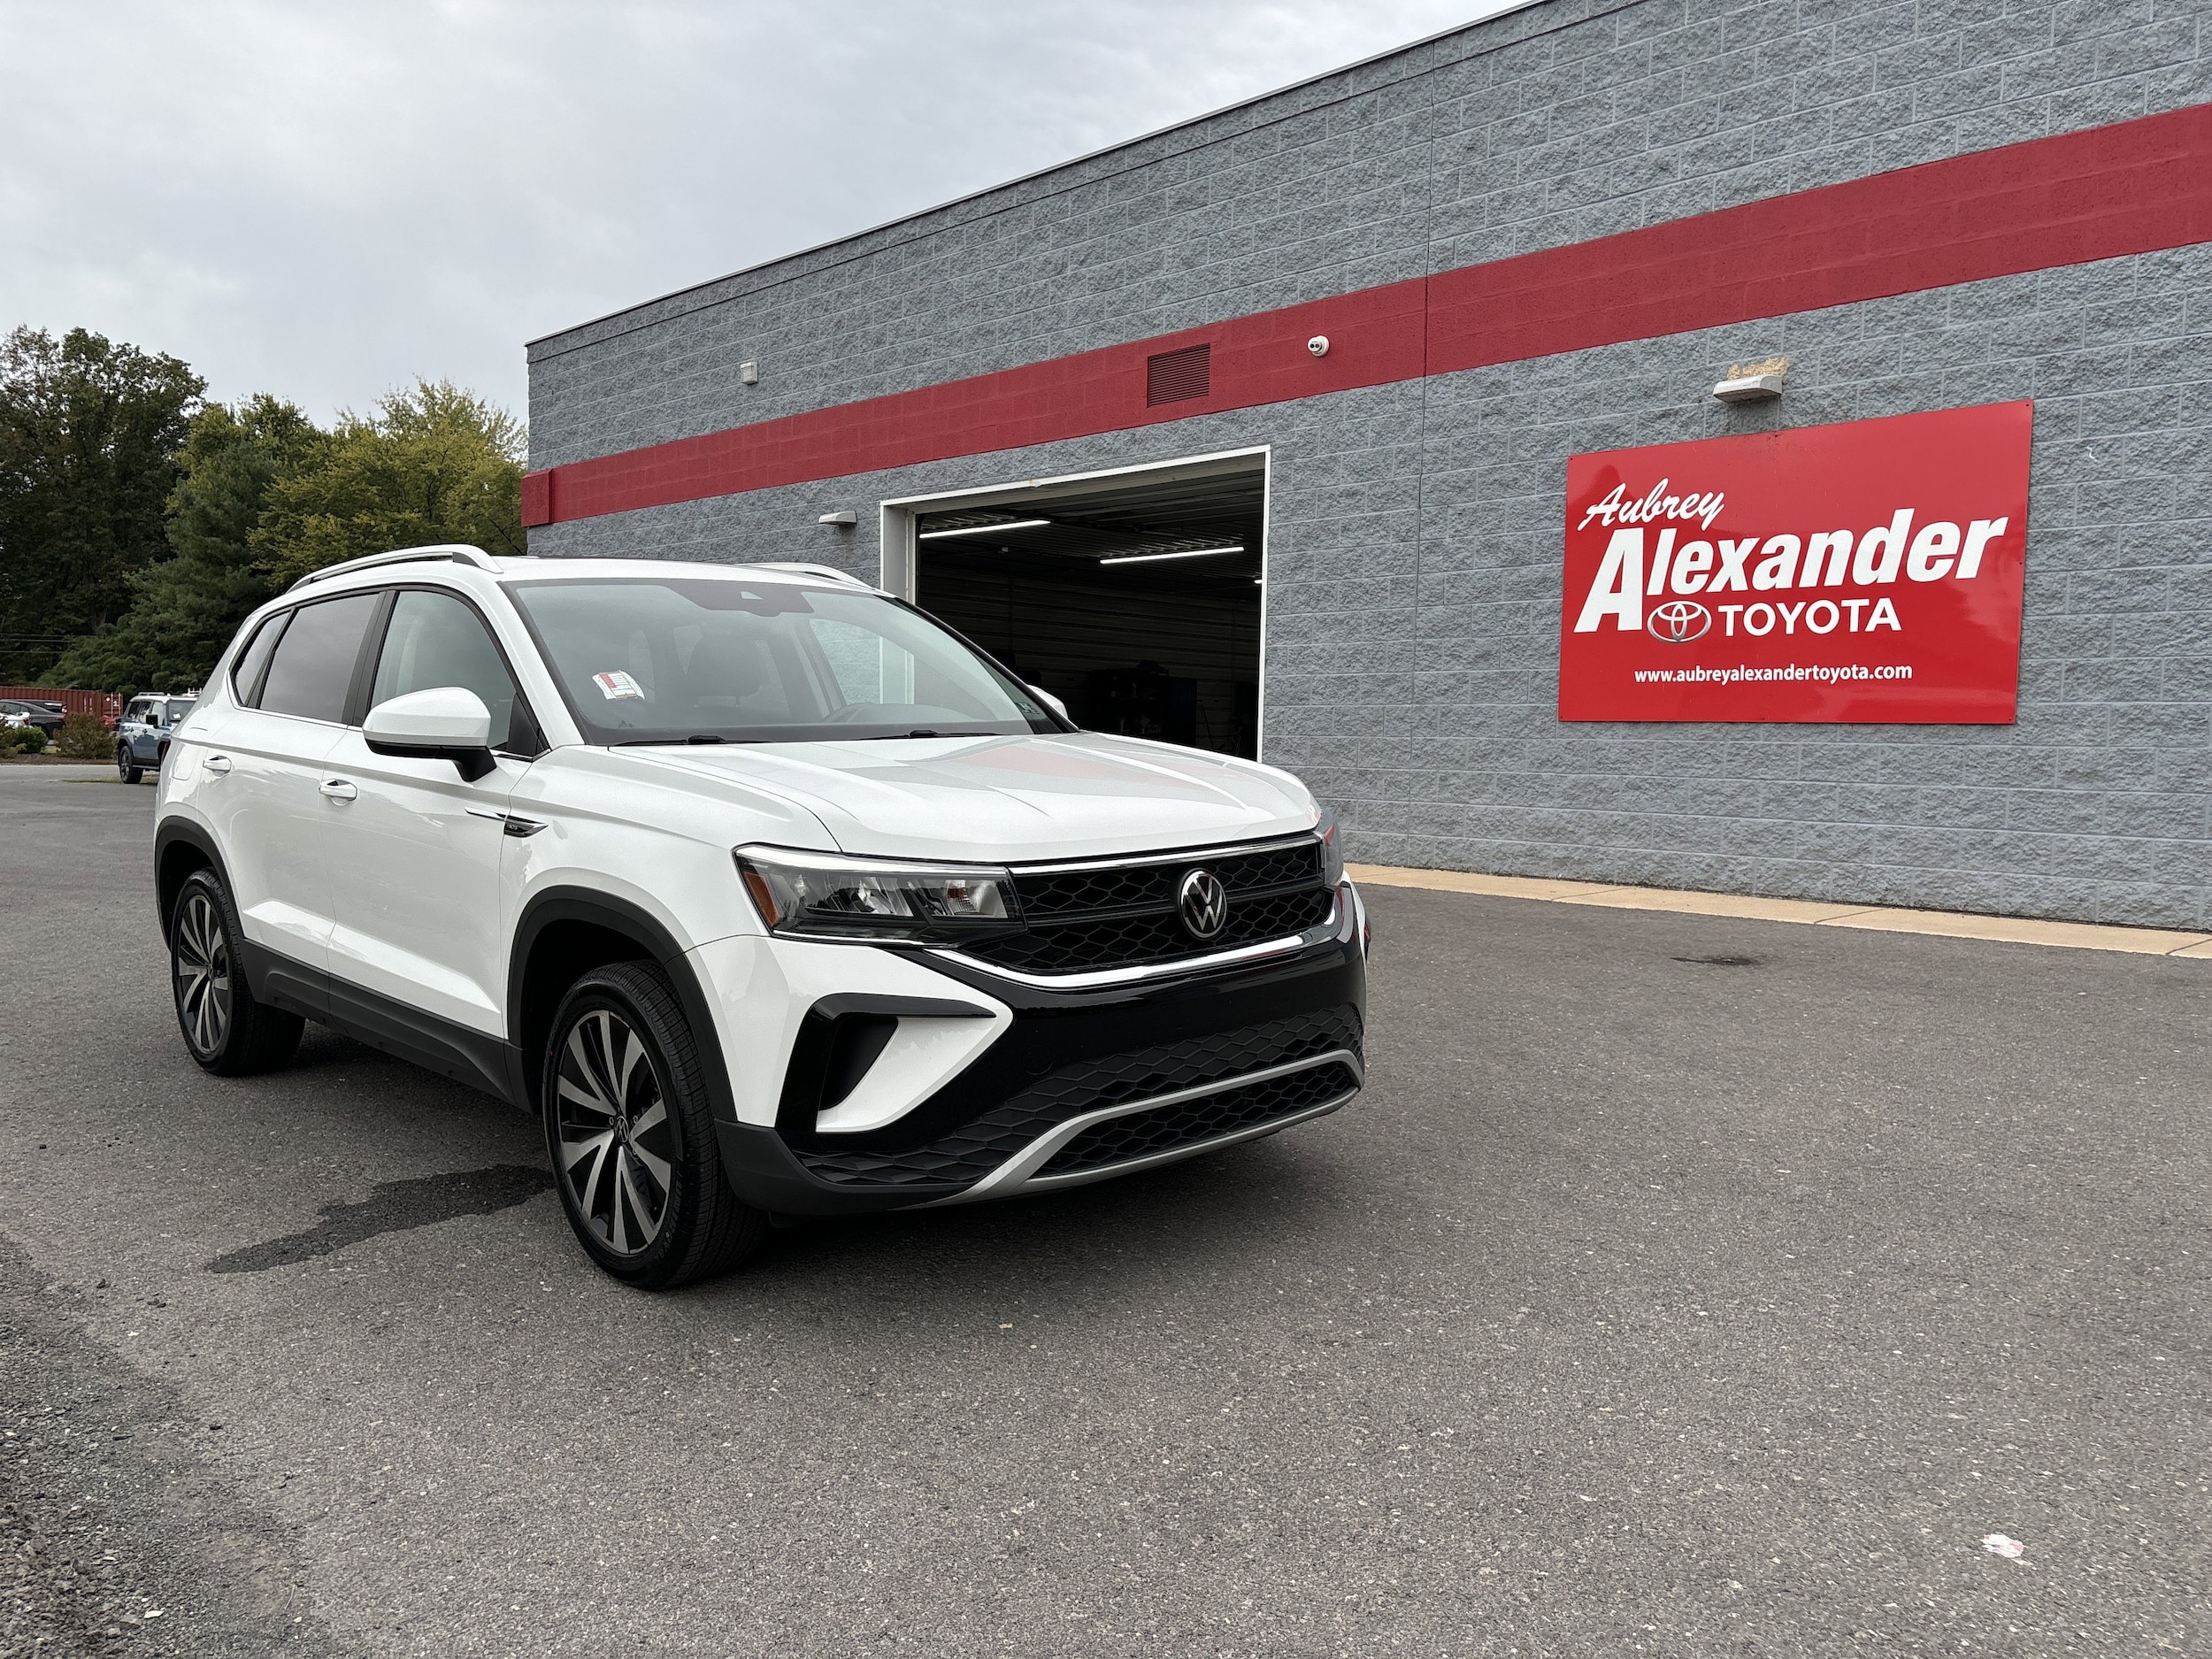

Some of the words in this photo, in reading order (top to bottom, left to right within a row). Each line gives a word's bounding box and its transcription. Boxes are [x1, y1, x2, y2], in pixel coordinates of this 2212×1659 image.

[1577, 477, 1725, 532] Aubrey
[1573, 507, 2009, 634] Alexander
[1717, 597, 1902, 637] TOYOTA
[1634, 663, 1913, 686] www.aubreyalexandertoyota.com
